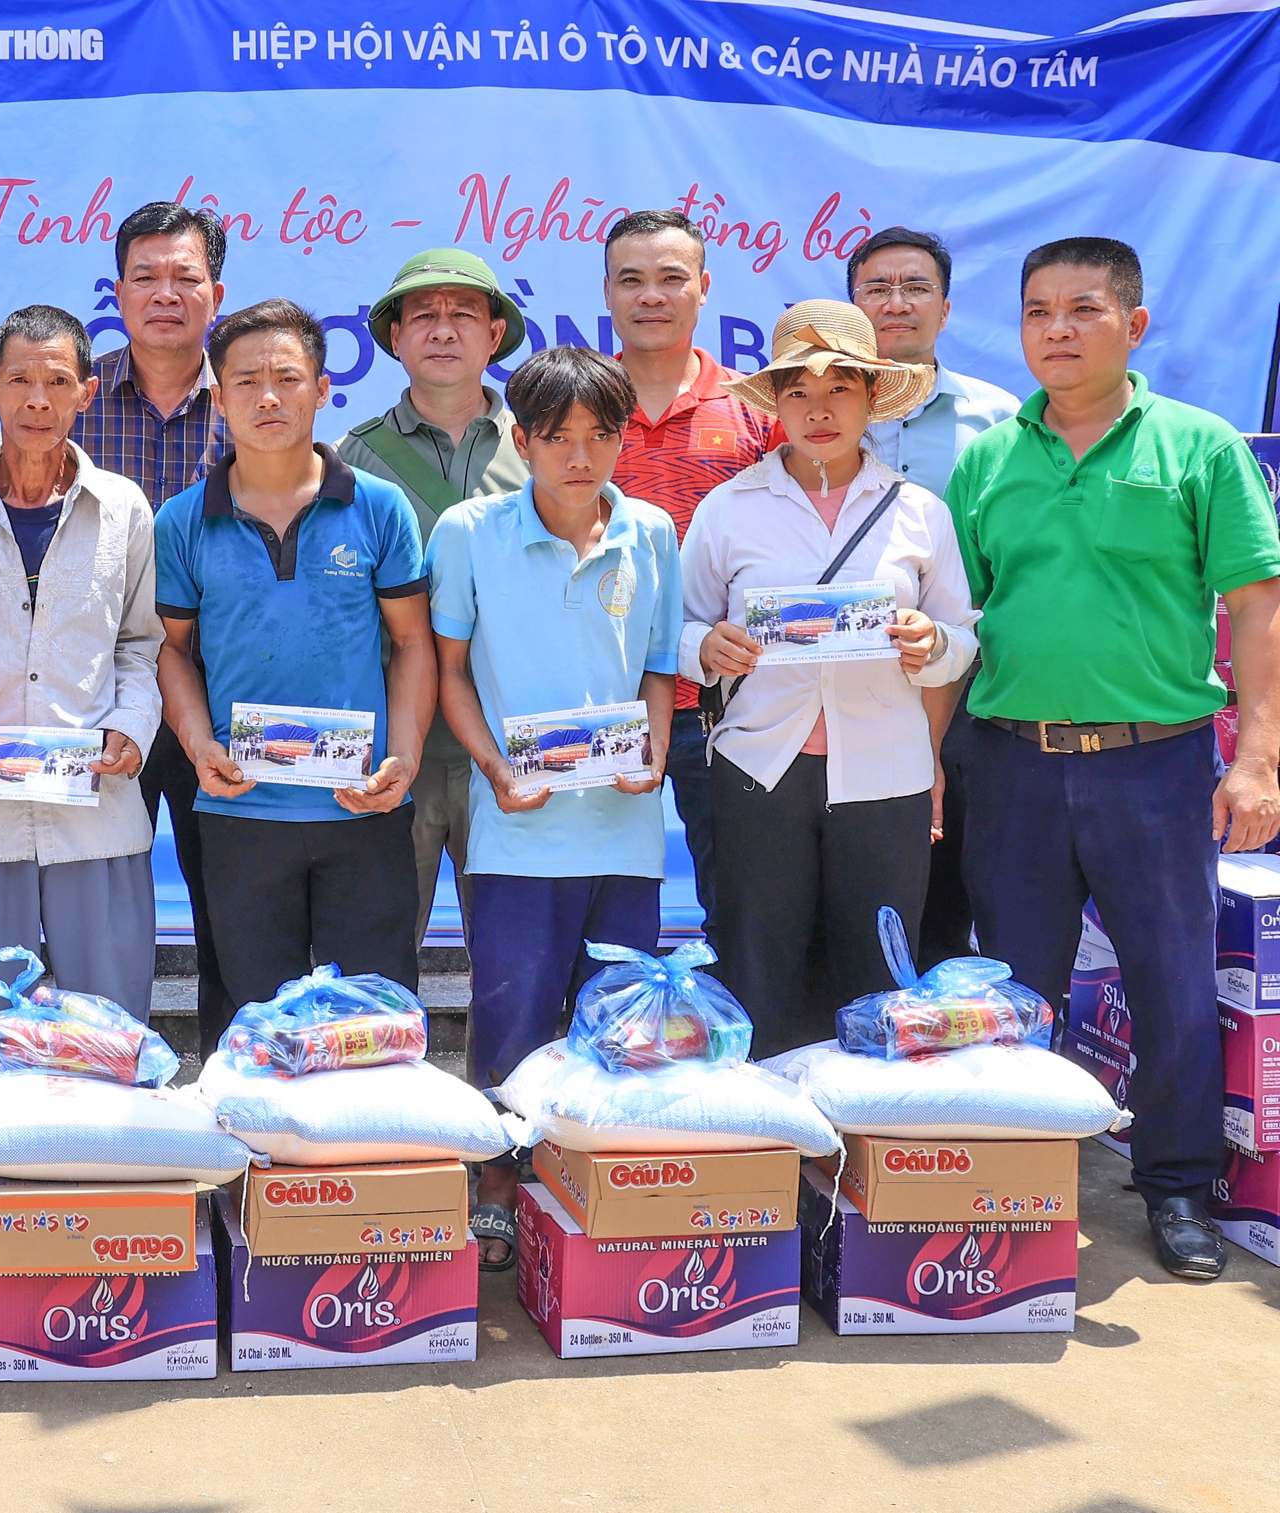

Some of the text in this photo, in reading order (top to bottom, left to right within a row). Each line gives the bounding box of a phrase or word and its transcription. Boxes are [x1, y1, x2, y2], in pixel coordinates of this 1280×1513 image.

[232, 19, 1099, 88] HIỆP HỘI VẬN TẢI Ô TÔ VN & CÁC NHÀ HẢO TÂM
[279, 187, 368, 256] tộc
[884, 1148, 971, 1173] Gấu Đỏ
[610, 1162, 696, 1188] Gấu Đỏ
[265, 1178, 354, 1205] Gấu Đỏ
[972, 1195, 1063, 1216] Gà Sợi Phở
[32, 1210, 60, 1232] Sợi
[64, 1214, 90, 1232] Gà
[690, 1207, 780, 1230] Gà Sợi Phở
[868, 1222, 1052, 1234] NƯỚC KHOÁNG THIÊN NHIÊN
[360, 1225, 455, 1248] Gà Sợi Phở
[598, 1236, 768, 1253] NATURAL MINERAL WATER
[92, 1235, 185, 1263] Gấu Đỏ
[261, 1251, 452, 1268] NƯỚC KHOÁNG THIÊN NHIÊN
[914, 1260, 996, 1296] Oris
[638, 1278, 720, 1314] Oris
[310, 1293, 395, 1328] Oris
[1028, 1307, 1068, 1317] KHOÁNG
[43, 1306, 130, 1342] Oris
[752, 1320, 792, 1332] KHOÁNG
[428, 1338, 470, 1348] KHOÁNG
[166, 1354, 209, 1365] KHOÁNG
